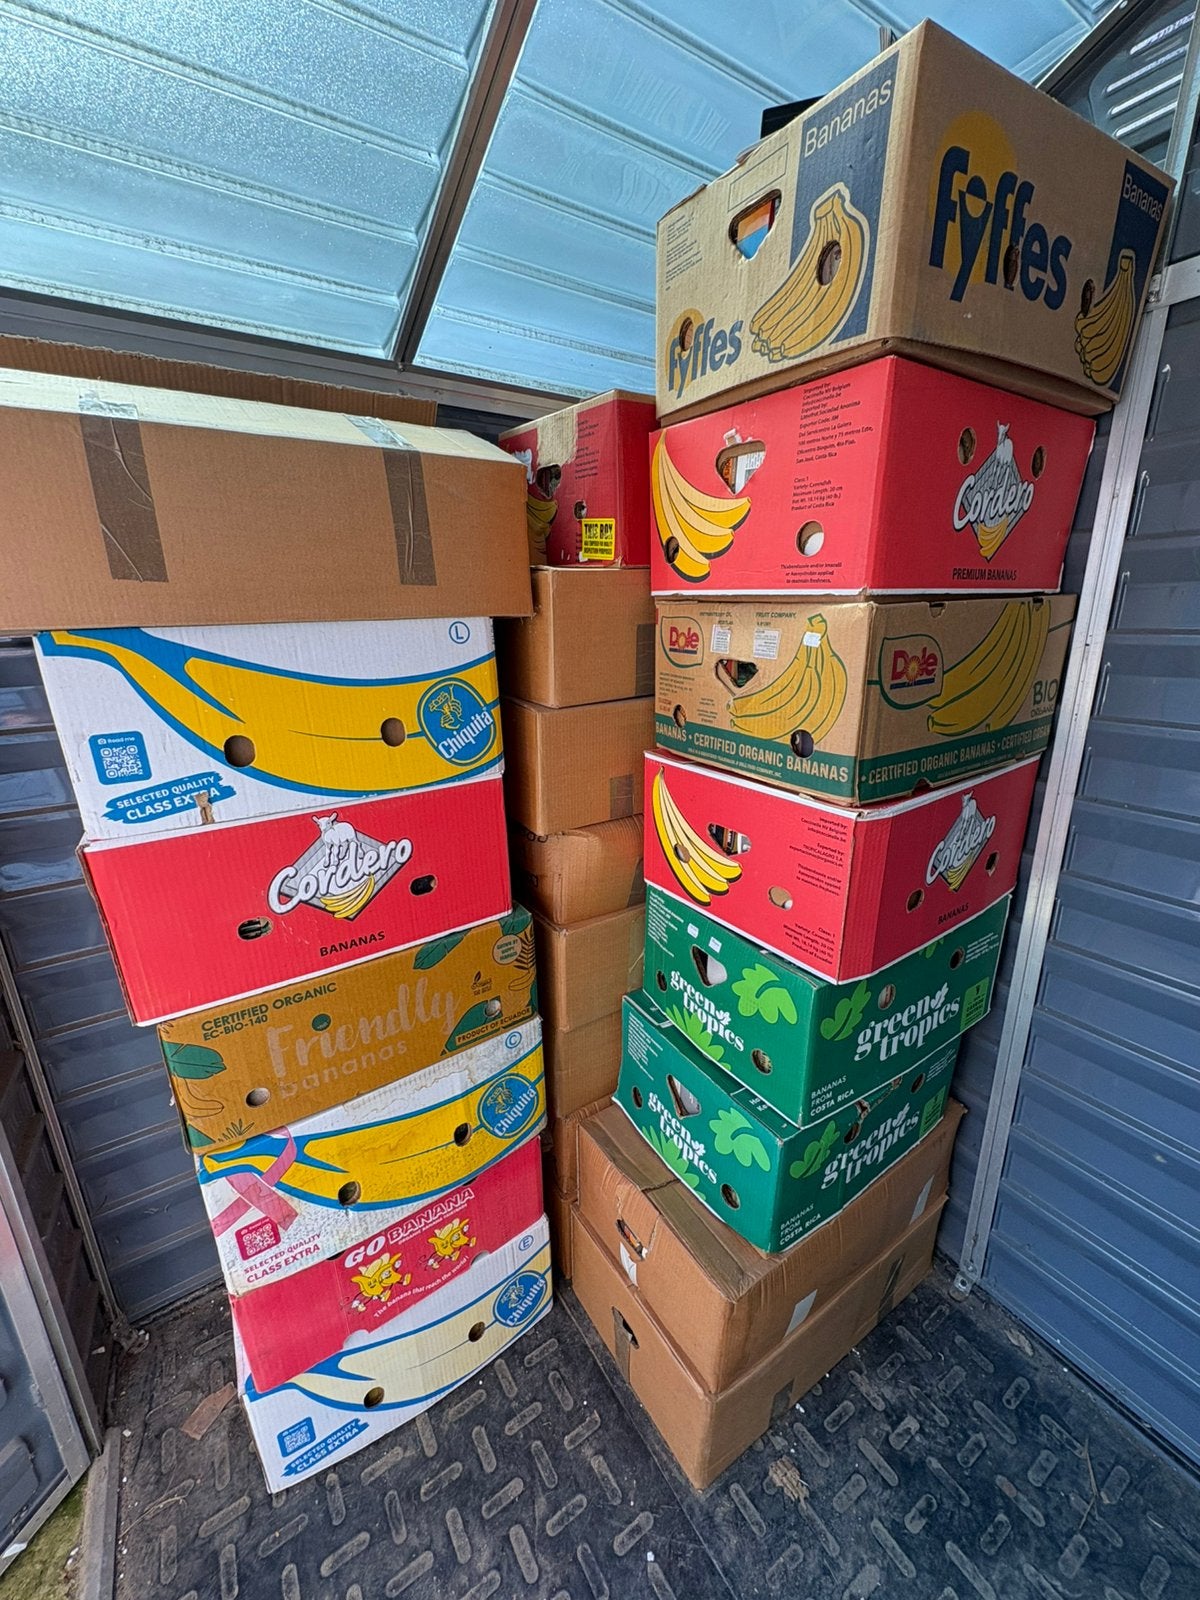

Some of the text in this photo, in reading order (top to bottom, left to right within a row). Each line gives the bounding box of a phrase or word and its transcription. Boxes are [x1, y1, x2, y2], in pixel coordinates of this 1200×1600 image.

[804, 79, 893, 158] Bananas
[1123, 173, 1163, 222] Bananas
[929, 145, 1072, 310] fyffes
[668, 316, 743, 399] fyffes
[953, 467, 1035, 533] Cordero
[952, 568, 1017, 581] PREMIUM BANANAS
[669, 626, 700, 649] Dole
[890, 646, 938, 682] Dole
[1033, 678, 1058, 705] BIO
[438, 708, 494, 760] Chiquita
[655, 720, 687, 742] BANANAS
[694, 732, 736, 755] CERTIFIED
[738, 743, 784, 768] ORGANIC
[787, 756, 849, 783] BANANAS
[869, 760, 918, 784] CERTIFIED
[920, 750, 958, 772] ORGANIC
[960, 740, 996, 761] BANANAS
[1002, 729, 1033, 750] CERTIFIED
[116, 776, 215, 810] SELECTED QUALITY
[126, 787, 221, 821] CLASS EXTA
[925, 816, 996, 886] Cordero
[268, 838, 413, 914] Cordero
[938, 903, 970, 925] BANANAS
[320, 931, 386, 957] BANANAS
[201, 982, 337, 1032] CERTIFIED ORGANIC
[670, 970, 716, 1020] green
[203, 1014, 268, 1041] EC-BIO-140
[266, 976, 461, 1078] Friendly
[457, 1008, 531, 1043] PRODUCT OF ECUADOR
[683, 991, 745, 1052] tropics
[854, 995, 934, 1062] green
[880, 997, 961, 1062] tropics
[279, 1040, 408, 1099] bananas
[811, 1075, 847, 1099] BANANAS
[493, 1087, 537, 1137] Chiquita
[648, 1093, 694, 1144] green
[810, 1089, 855, 1117] COSTA RICA
[811, 1091, 833, 1108] FROM
[660, 1113, 717, 1184] tropics
[821, 1117, 892, 1190] green
[845, 1111, 920, 1184] tropics
[344, 1187, 475, 1269] GO BANANA
[779, 1213, 822, 1246] COSTA RICA
[780, 1203, 815, 1229] BANANAS
[780, 1219, 802, 1237] FROM
[244, 1233, 322, 1274] SELECTED QUALITY
[246, 1244, 321, 1283] CLASS EXTRA
[374, 1305, 387, 1318] The
[387, 1291, 412, 1307] banana
[442, 1272, 452, 1281] the
[506, 1279, 545, 1326] Chiquita
[291, 1443, 326, 1468] SELECTED
[326, 1420, 356, 1445] QUALITY
[296, 1428, 359, 1472] CLASS EXTRA
